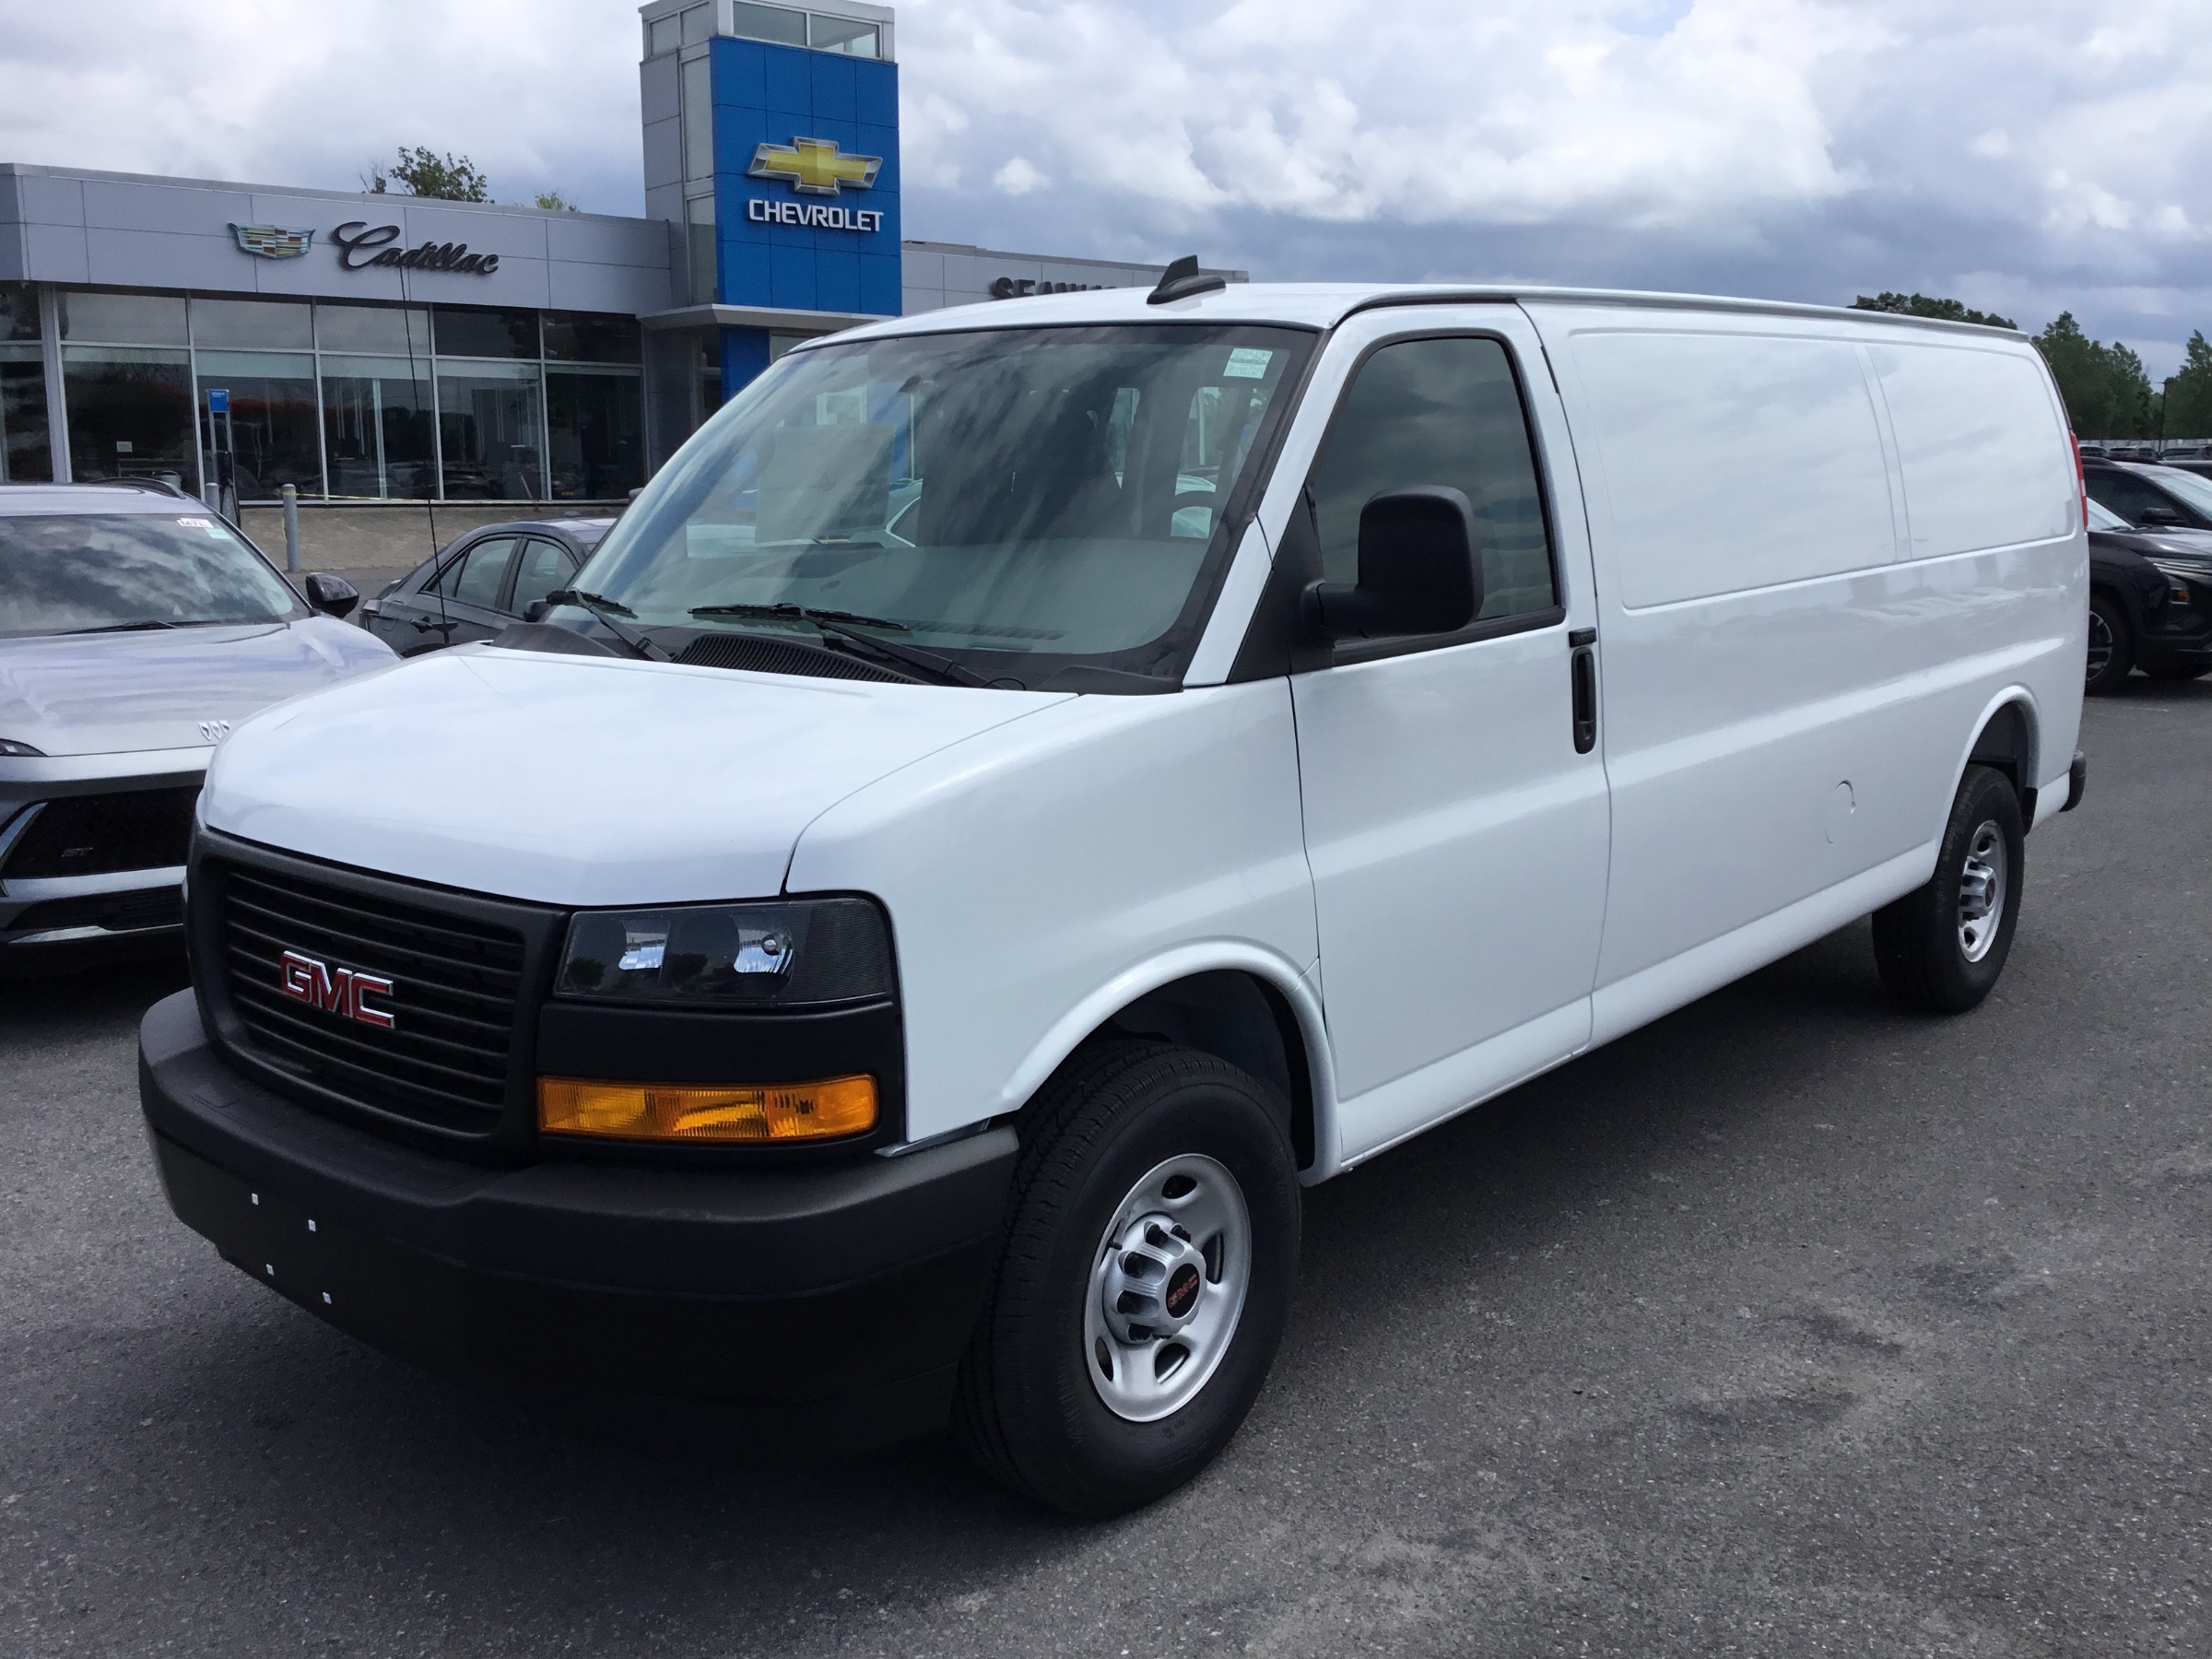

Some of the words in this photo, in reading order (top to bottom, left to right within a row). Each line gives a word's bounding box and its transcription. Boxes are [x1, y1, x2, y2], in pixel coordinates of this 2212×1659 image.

[749, 198, 885, 232] CHEVROLET
[333, 221, 500, 275] Cadillac
[280, 950, 394, 1029] GMC
[1167, 1273, 1198, 1309] GMC
